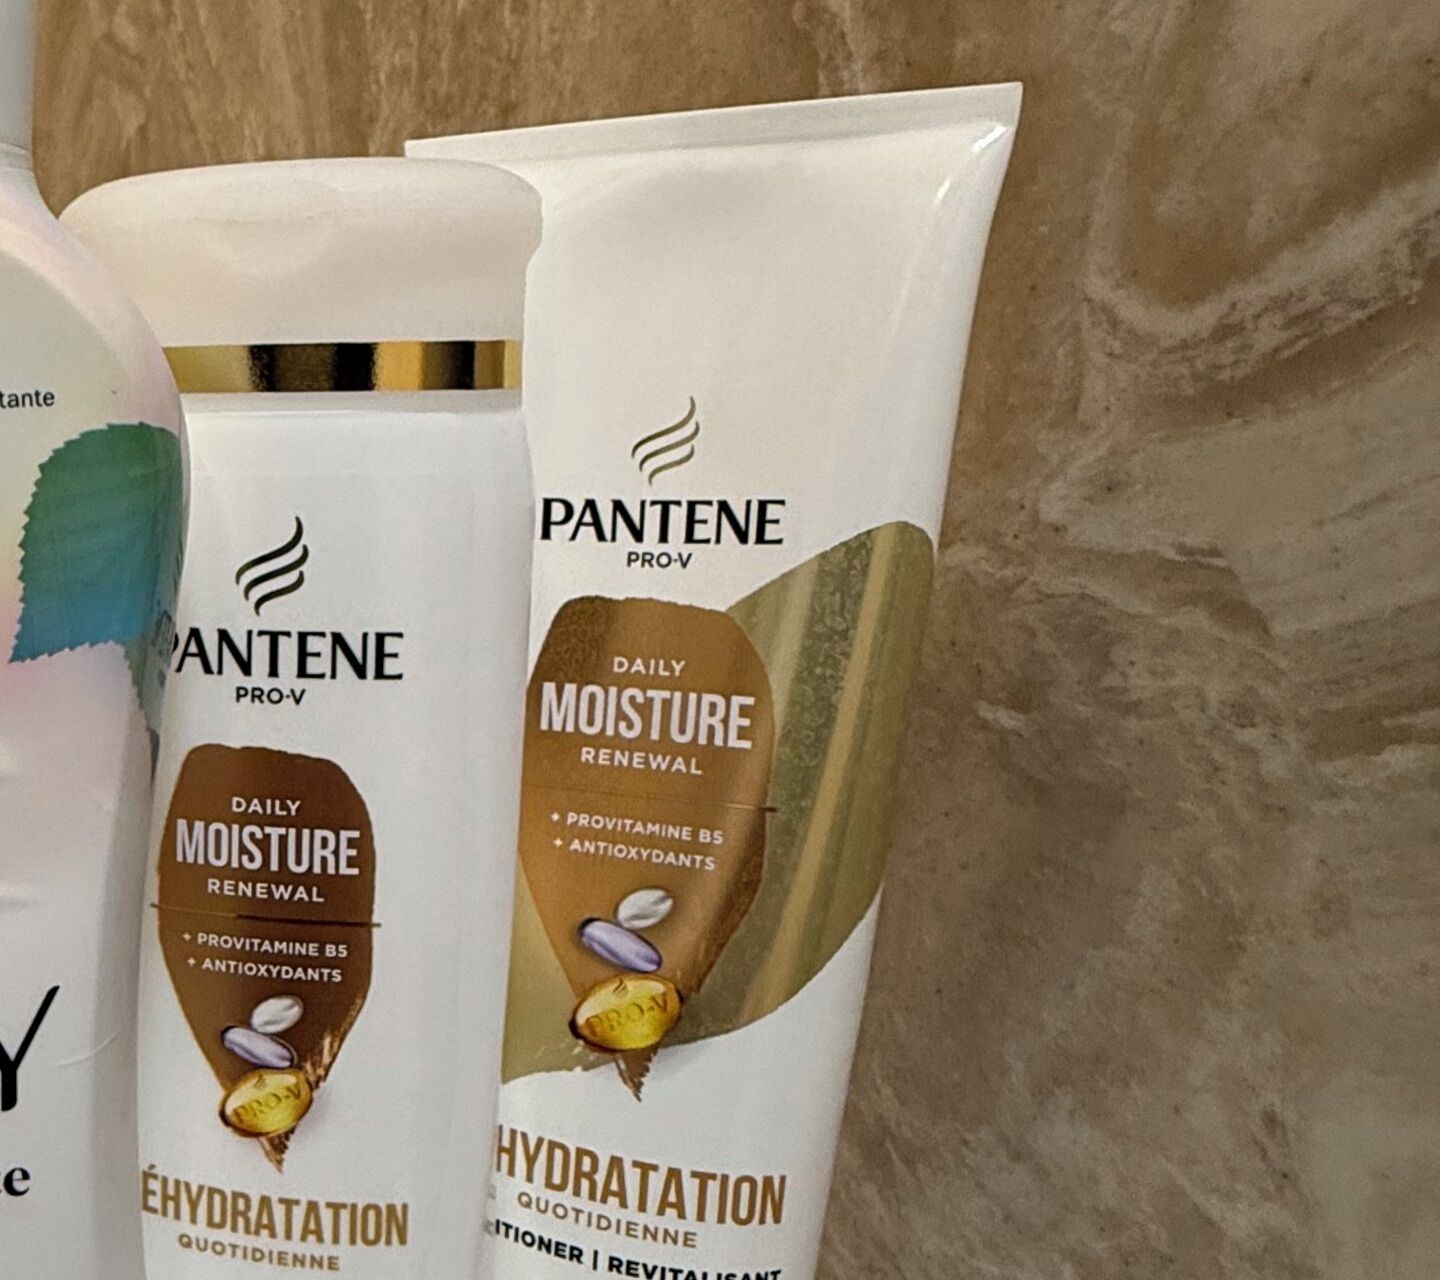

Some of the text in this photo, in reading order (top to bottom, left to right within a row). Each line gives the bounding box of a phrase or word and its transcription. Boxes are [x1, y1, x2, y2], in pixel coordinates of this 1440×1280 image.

[540, 497, 786, 545] PANTENE
[172, 627, 404, 680] ANTENE
[613, 656, 686, 677] DAILY
[540, 681, 756, 750] MOISTURE
[580, 746, 703, 775] RENEWAL
[232, 796, 301, 816] DAILY
[566, 811, 692, 842] PROVITAMINE
[175, 818, 360, 875] MOISTURE
[569, 838, 716, 871] ANTIOXYDANTS
[207, 878, 325, 902] RENEWAL
[197, 932, 319, 956] PROVITAMINE
[325, 944, 348, 958] B5
[202, 958, 342, 983] ANTIOXYDANTS
[496, 1124, 787, 1226] HYDRATATION
[141, 1163, 409, 1247] ÉHYDRATATION
[517, 1191, 698, 1249] QUOTIDIENNE
[178, 1233, 340, 1271] QUOTIDIENNE
[495, 1219, 584, 1265] ITIONER
